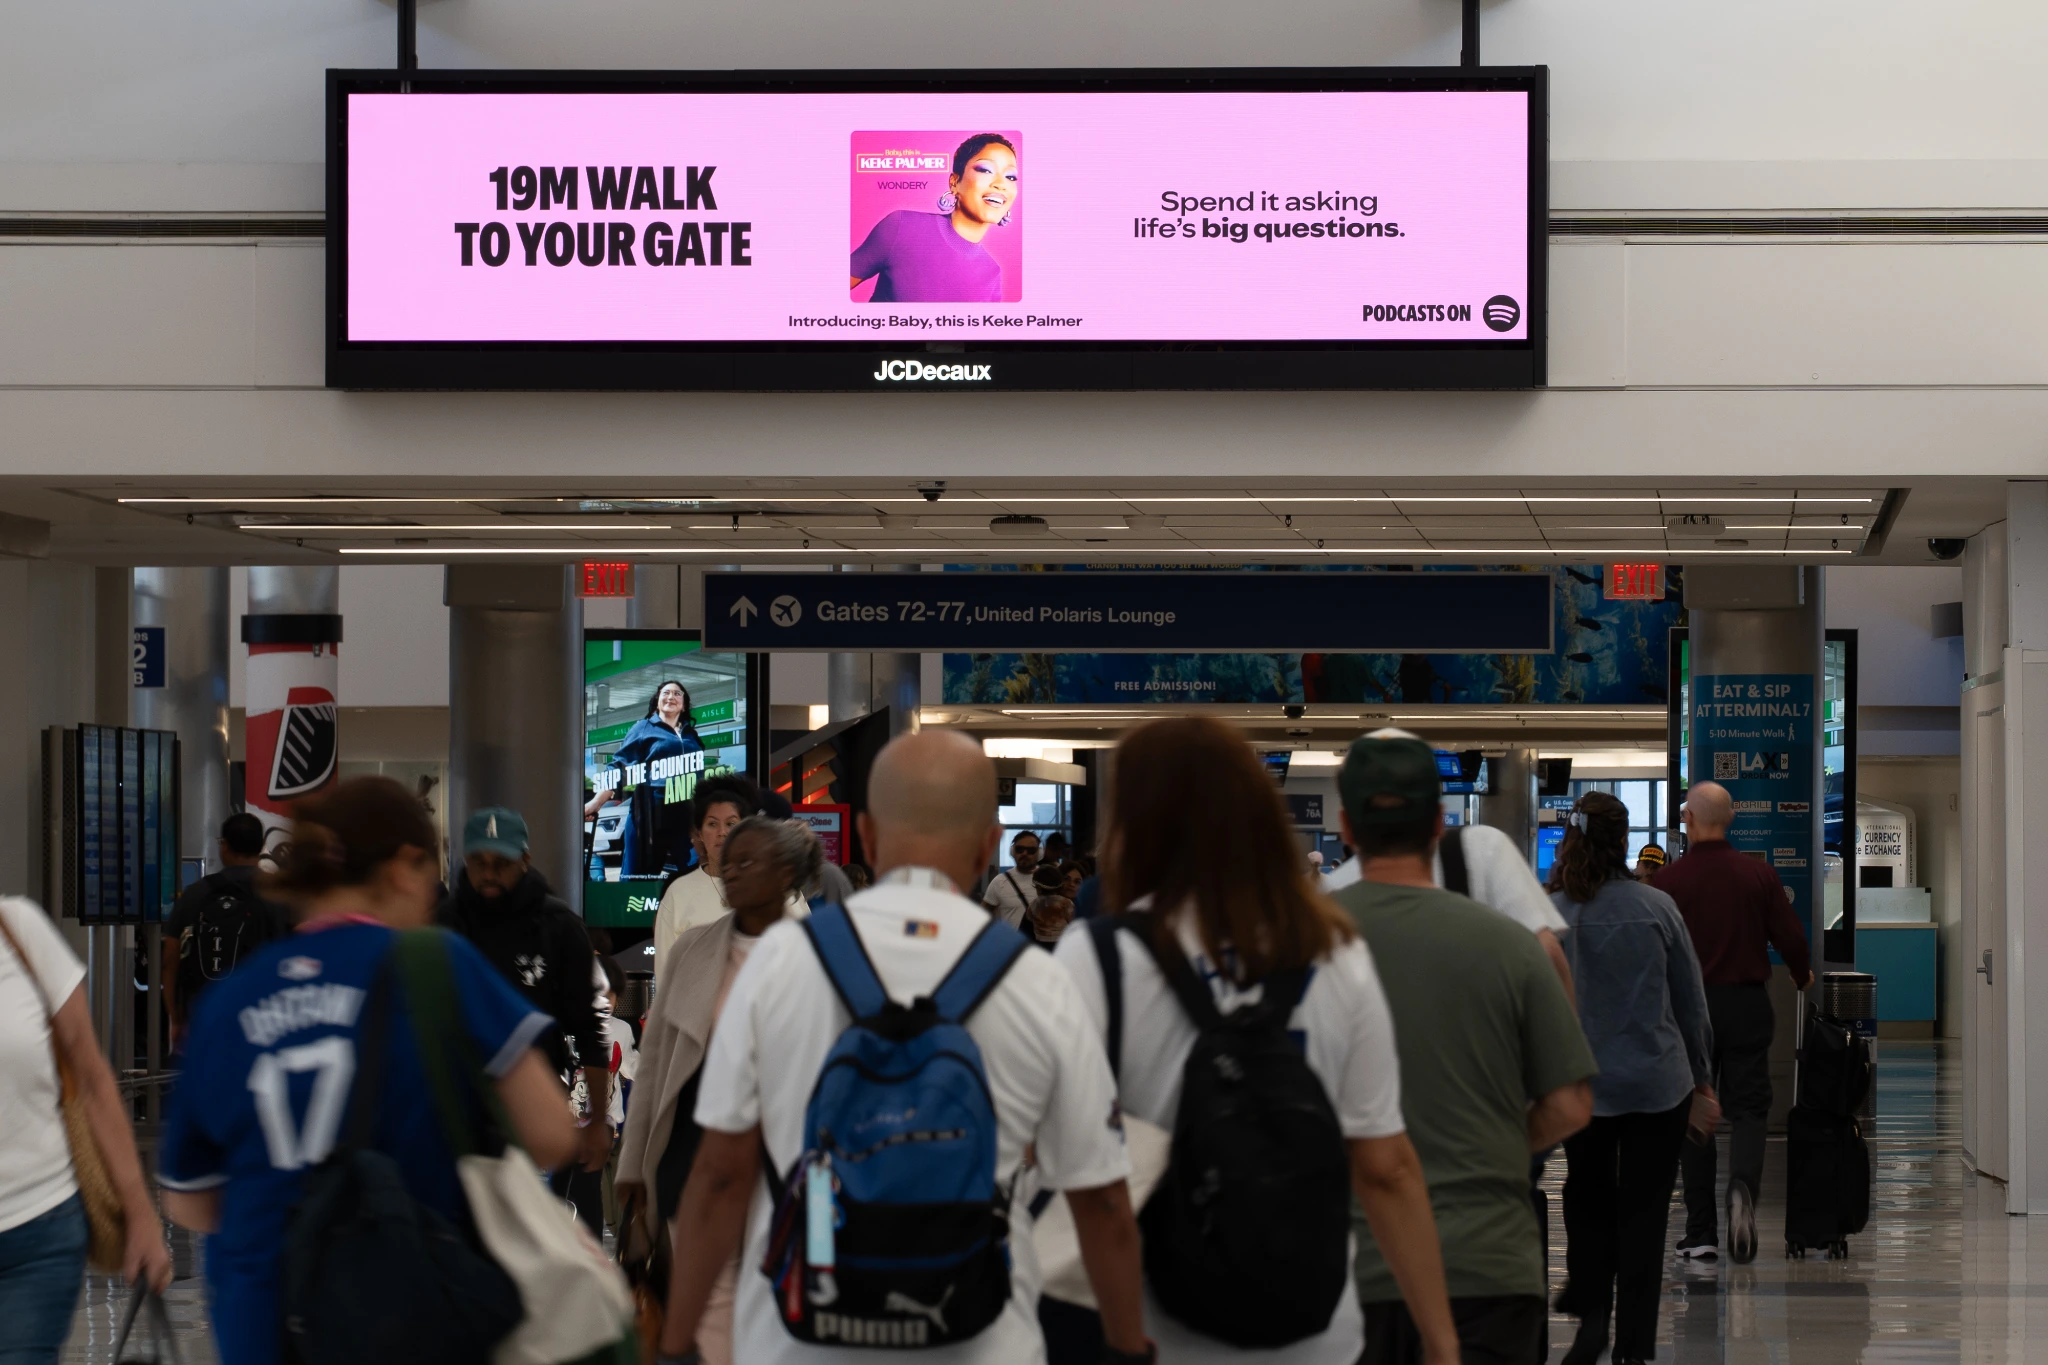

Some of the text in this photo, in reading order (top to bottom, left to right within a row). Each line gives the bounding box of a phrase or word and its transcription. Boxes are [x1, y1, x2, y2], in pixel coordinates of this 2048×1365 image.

[860, 157, 945, 168] KEKE PALMER
[489, 165, 718, 211] 19M WALK
[877, 181, 928, 190] WONDERY
[1162, 191, 1378, 217] Spend it asking
[1203, 216, 1249, 244] big
[1254, 216, 1406, 244] questions.
[455, 222, 752, 267] TO YOUR GATE
[1363, 304, 1472, 322] PODCASTS ON
[788, 315, 1083, 330] Introducing: Baby, this is Keke Palmer
[873, 359, 992, 382] JCDecaux
[583, 563, 629, 595] EXIT
[1613, 564, 1659, 596] EXIT
[816, 600, 890, 622] Gates
[974, 607, 1034, 623] United
[1039, 607, 1103, 623] Polaris
[1108, 607, 1176, 628] Lounge
[1114, 681, 1216, 691] FREE ADMISSION!
[1713, 684, 1791, 698] EAT & SIP
[701, 707, 726, 719] AISLE
[1696, 703, 1811, 718] AT TERMINAL 7
[1709, 729, 1786, 738] 5-10 Minute Walk
[1741, 751, 1779, 771] LAX
[593, 768, 621, 793] SKIP
[625, 762, 647, 786] THE
[651, 751, 705, 781] COUNTER
[664, 773, 697, 805] AND
[1305, 808, 1322, 818] 76A
[1740, 801, 1772, 809] GRILL
[1864, 832, 1902, 843] CURRENCY
[1864, 845, 1902, 855] EXCHANGE
